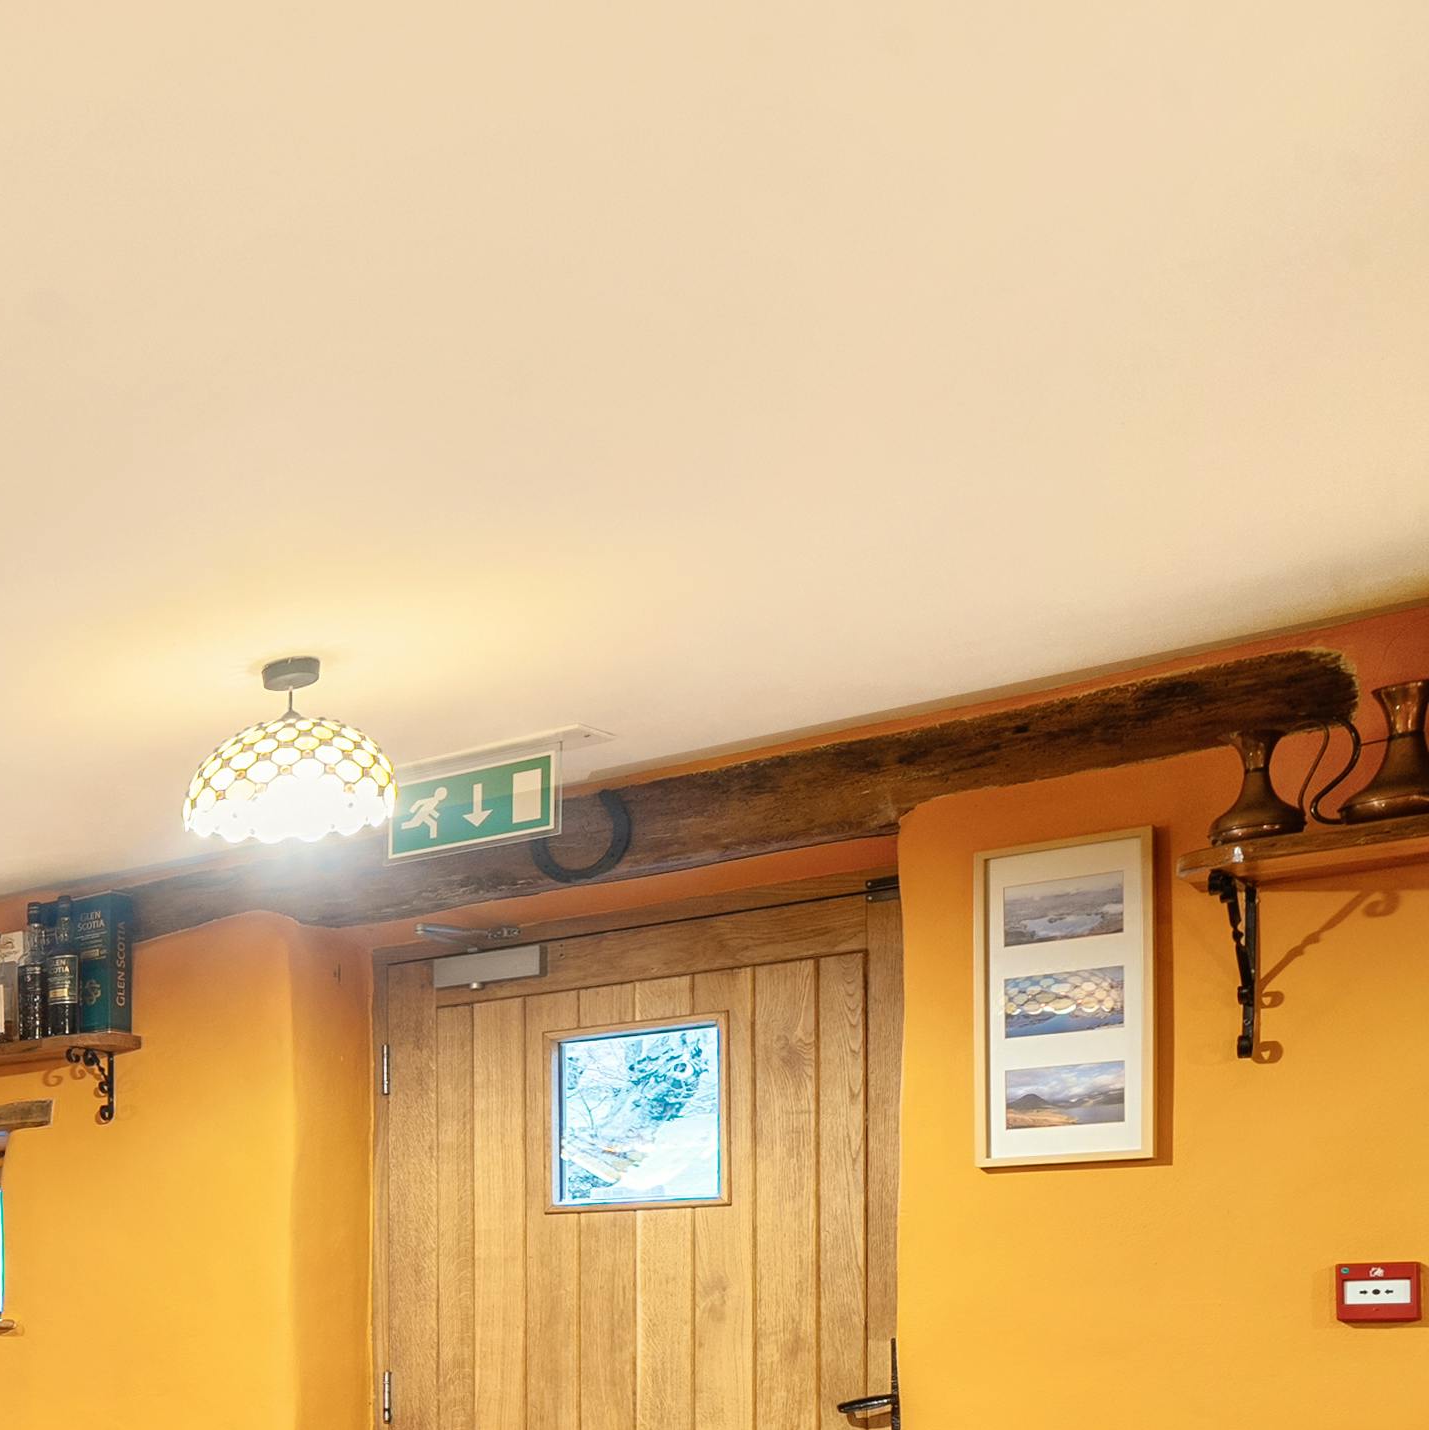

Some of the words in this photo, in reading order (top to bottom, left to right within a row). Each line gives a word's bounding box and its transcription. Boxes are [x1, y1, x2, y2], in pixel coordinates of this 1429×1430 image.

[77, 919, 105, 931] SCOTIA
[115, 921, 126, 969] SCOTIA
[116, 972, 126, 1007] GLEN
